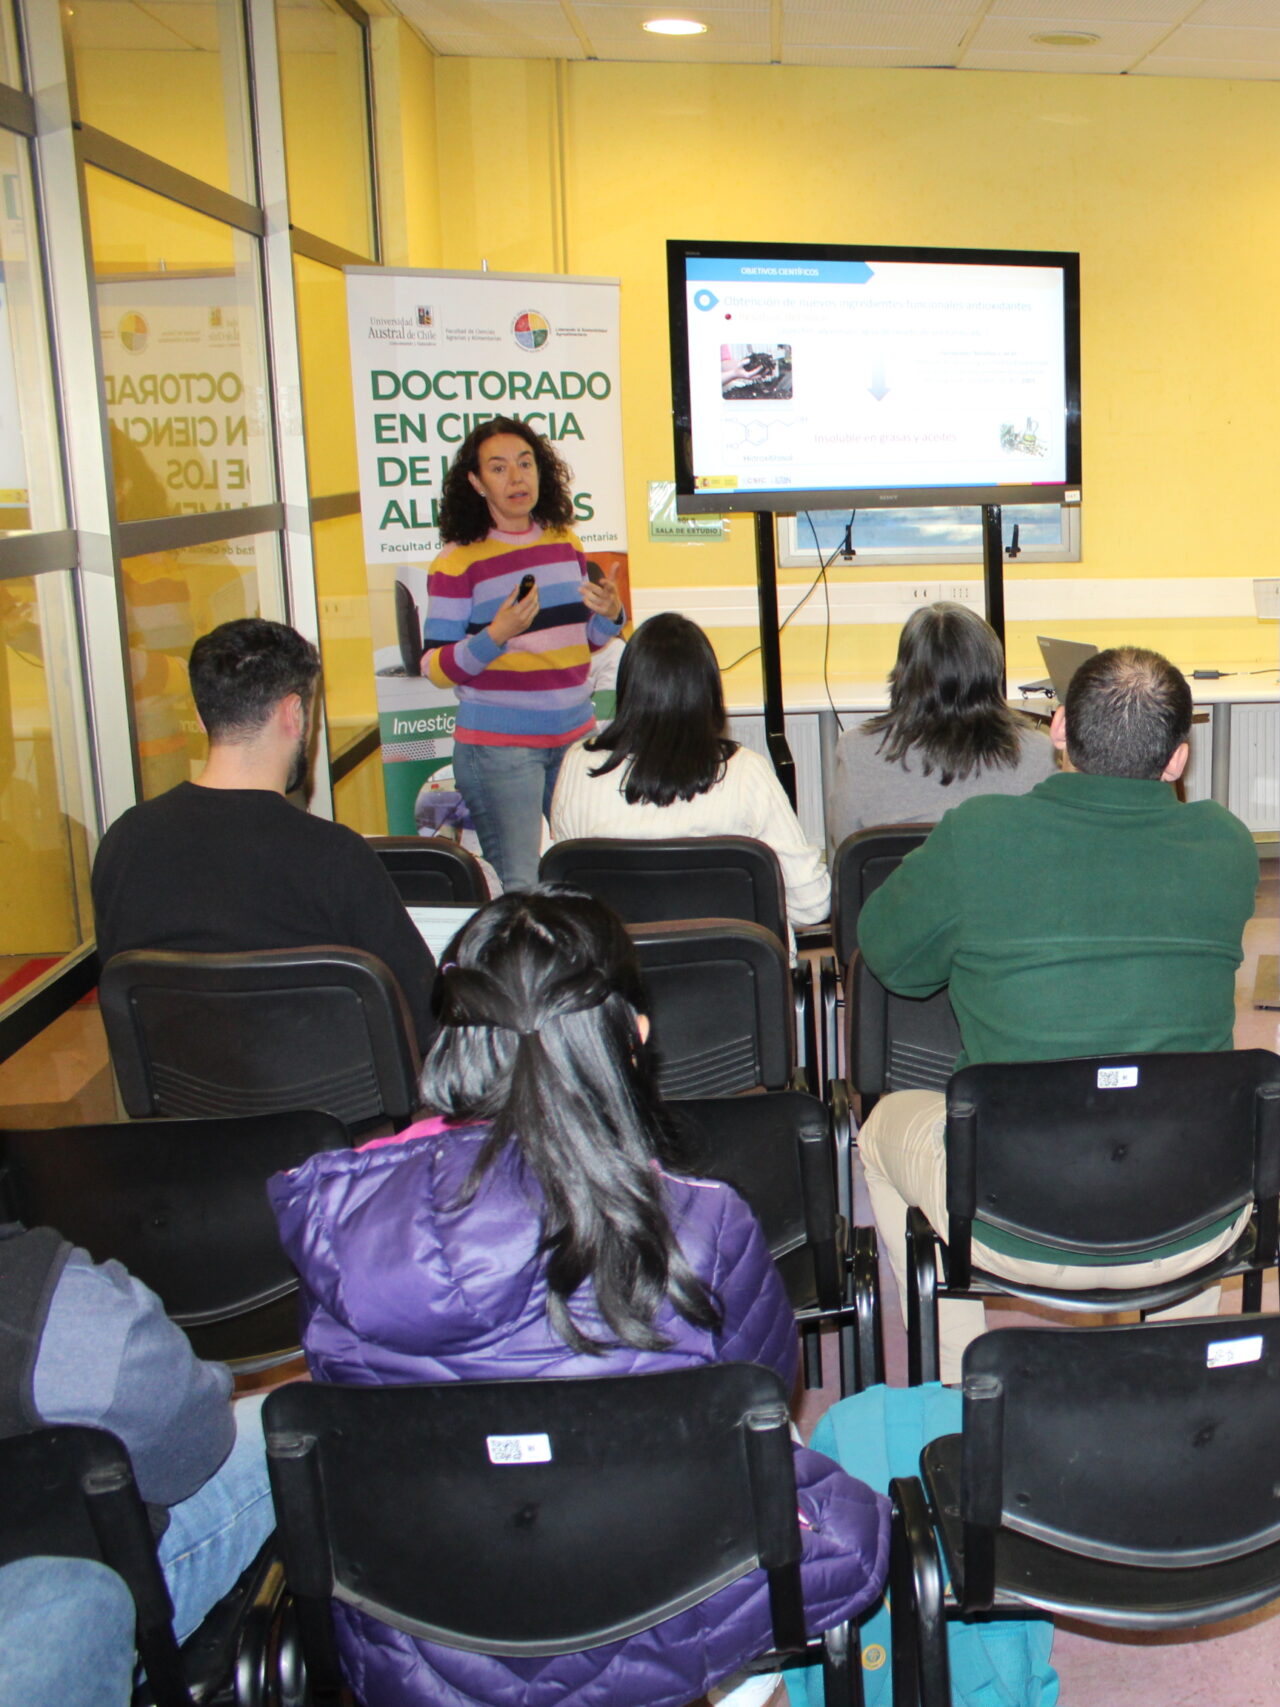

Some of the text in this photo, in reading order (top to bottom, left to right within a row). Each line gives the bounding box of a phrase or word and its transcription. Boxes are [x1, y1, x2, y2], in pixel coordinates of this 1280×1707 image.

[741, 267, 777, 276] OBJETIVOS
[370, 317, 413, 327] Universidad
[368, 326, 436, 340] Austral de Chile
[371, 370, 612, 400] DOCTORADO
[374, 411, 585, 443] EN CIECIA
[377, 456, 432, 487] DE
[381, 542, 432, 553] Facultad
